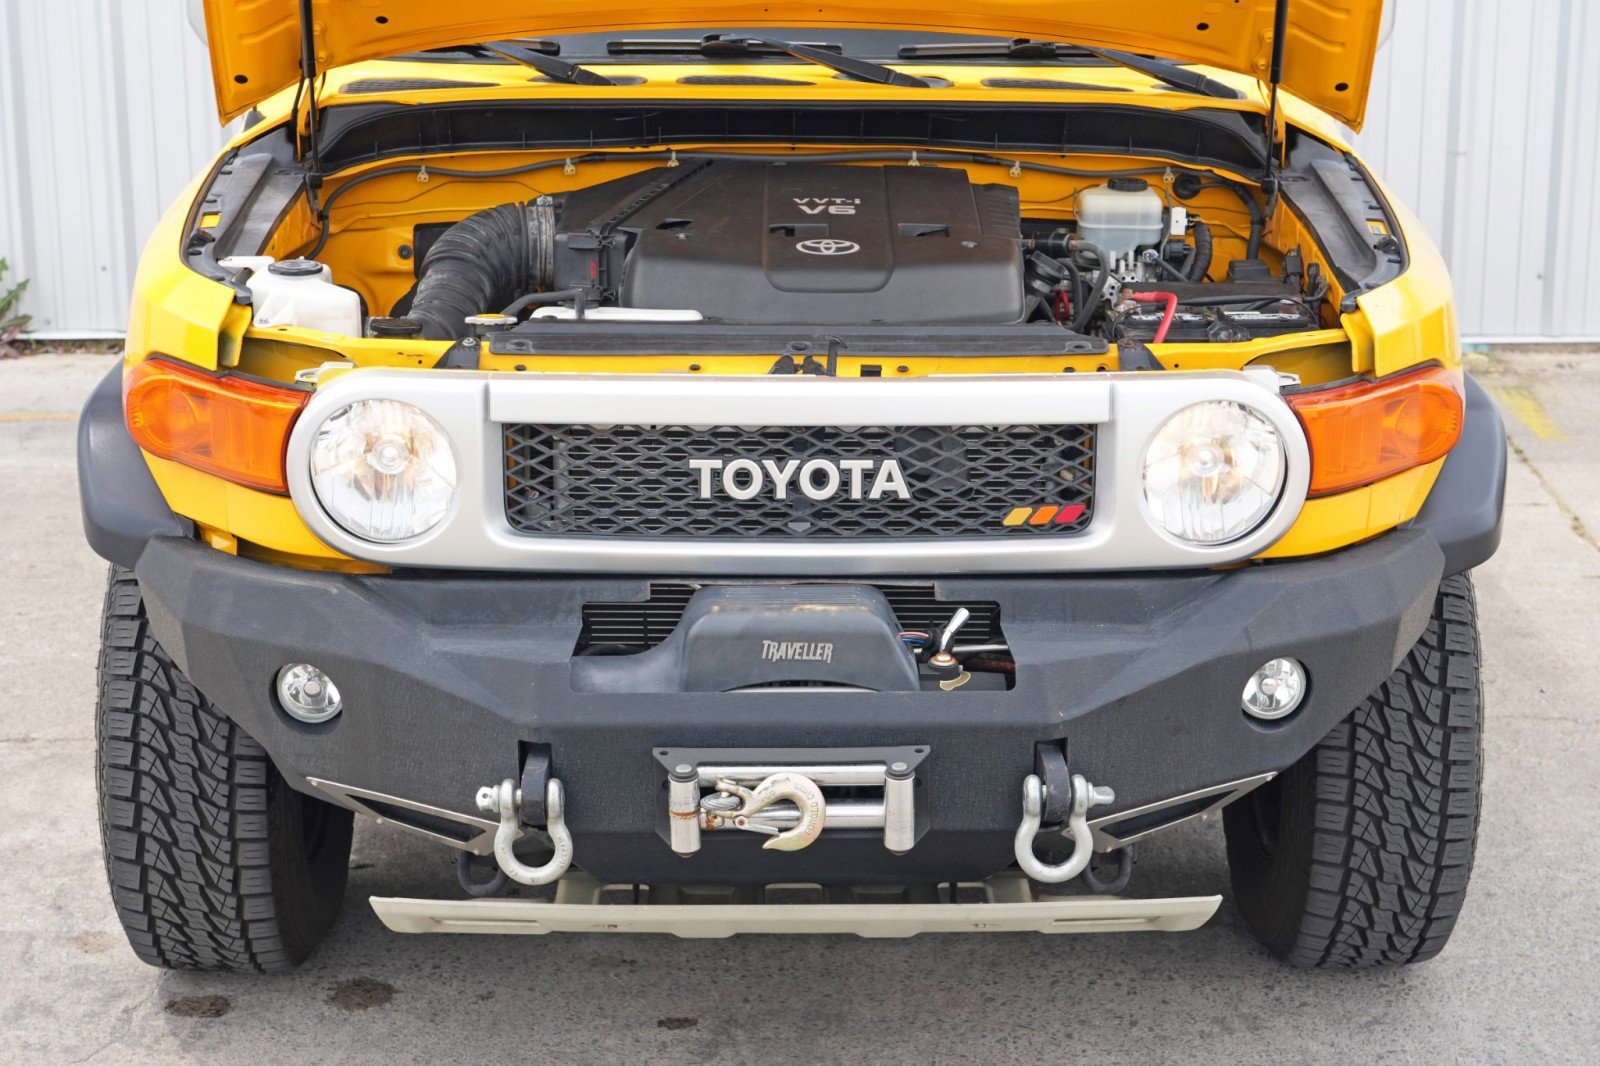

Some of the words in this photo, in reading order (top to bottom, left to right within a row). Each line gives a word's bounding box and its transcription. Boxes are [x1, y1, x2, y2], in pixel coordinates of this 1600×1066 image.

[798, 205, 856, 214] V6
[689, 458, 911, 500] TOYOTA
[762, 640, 834, 663] TRAVELLER
